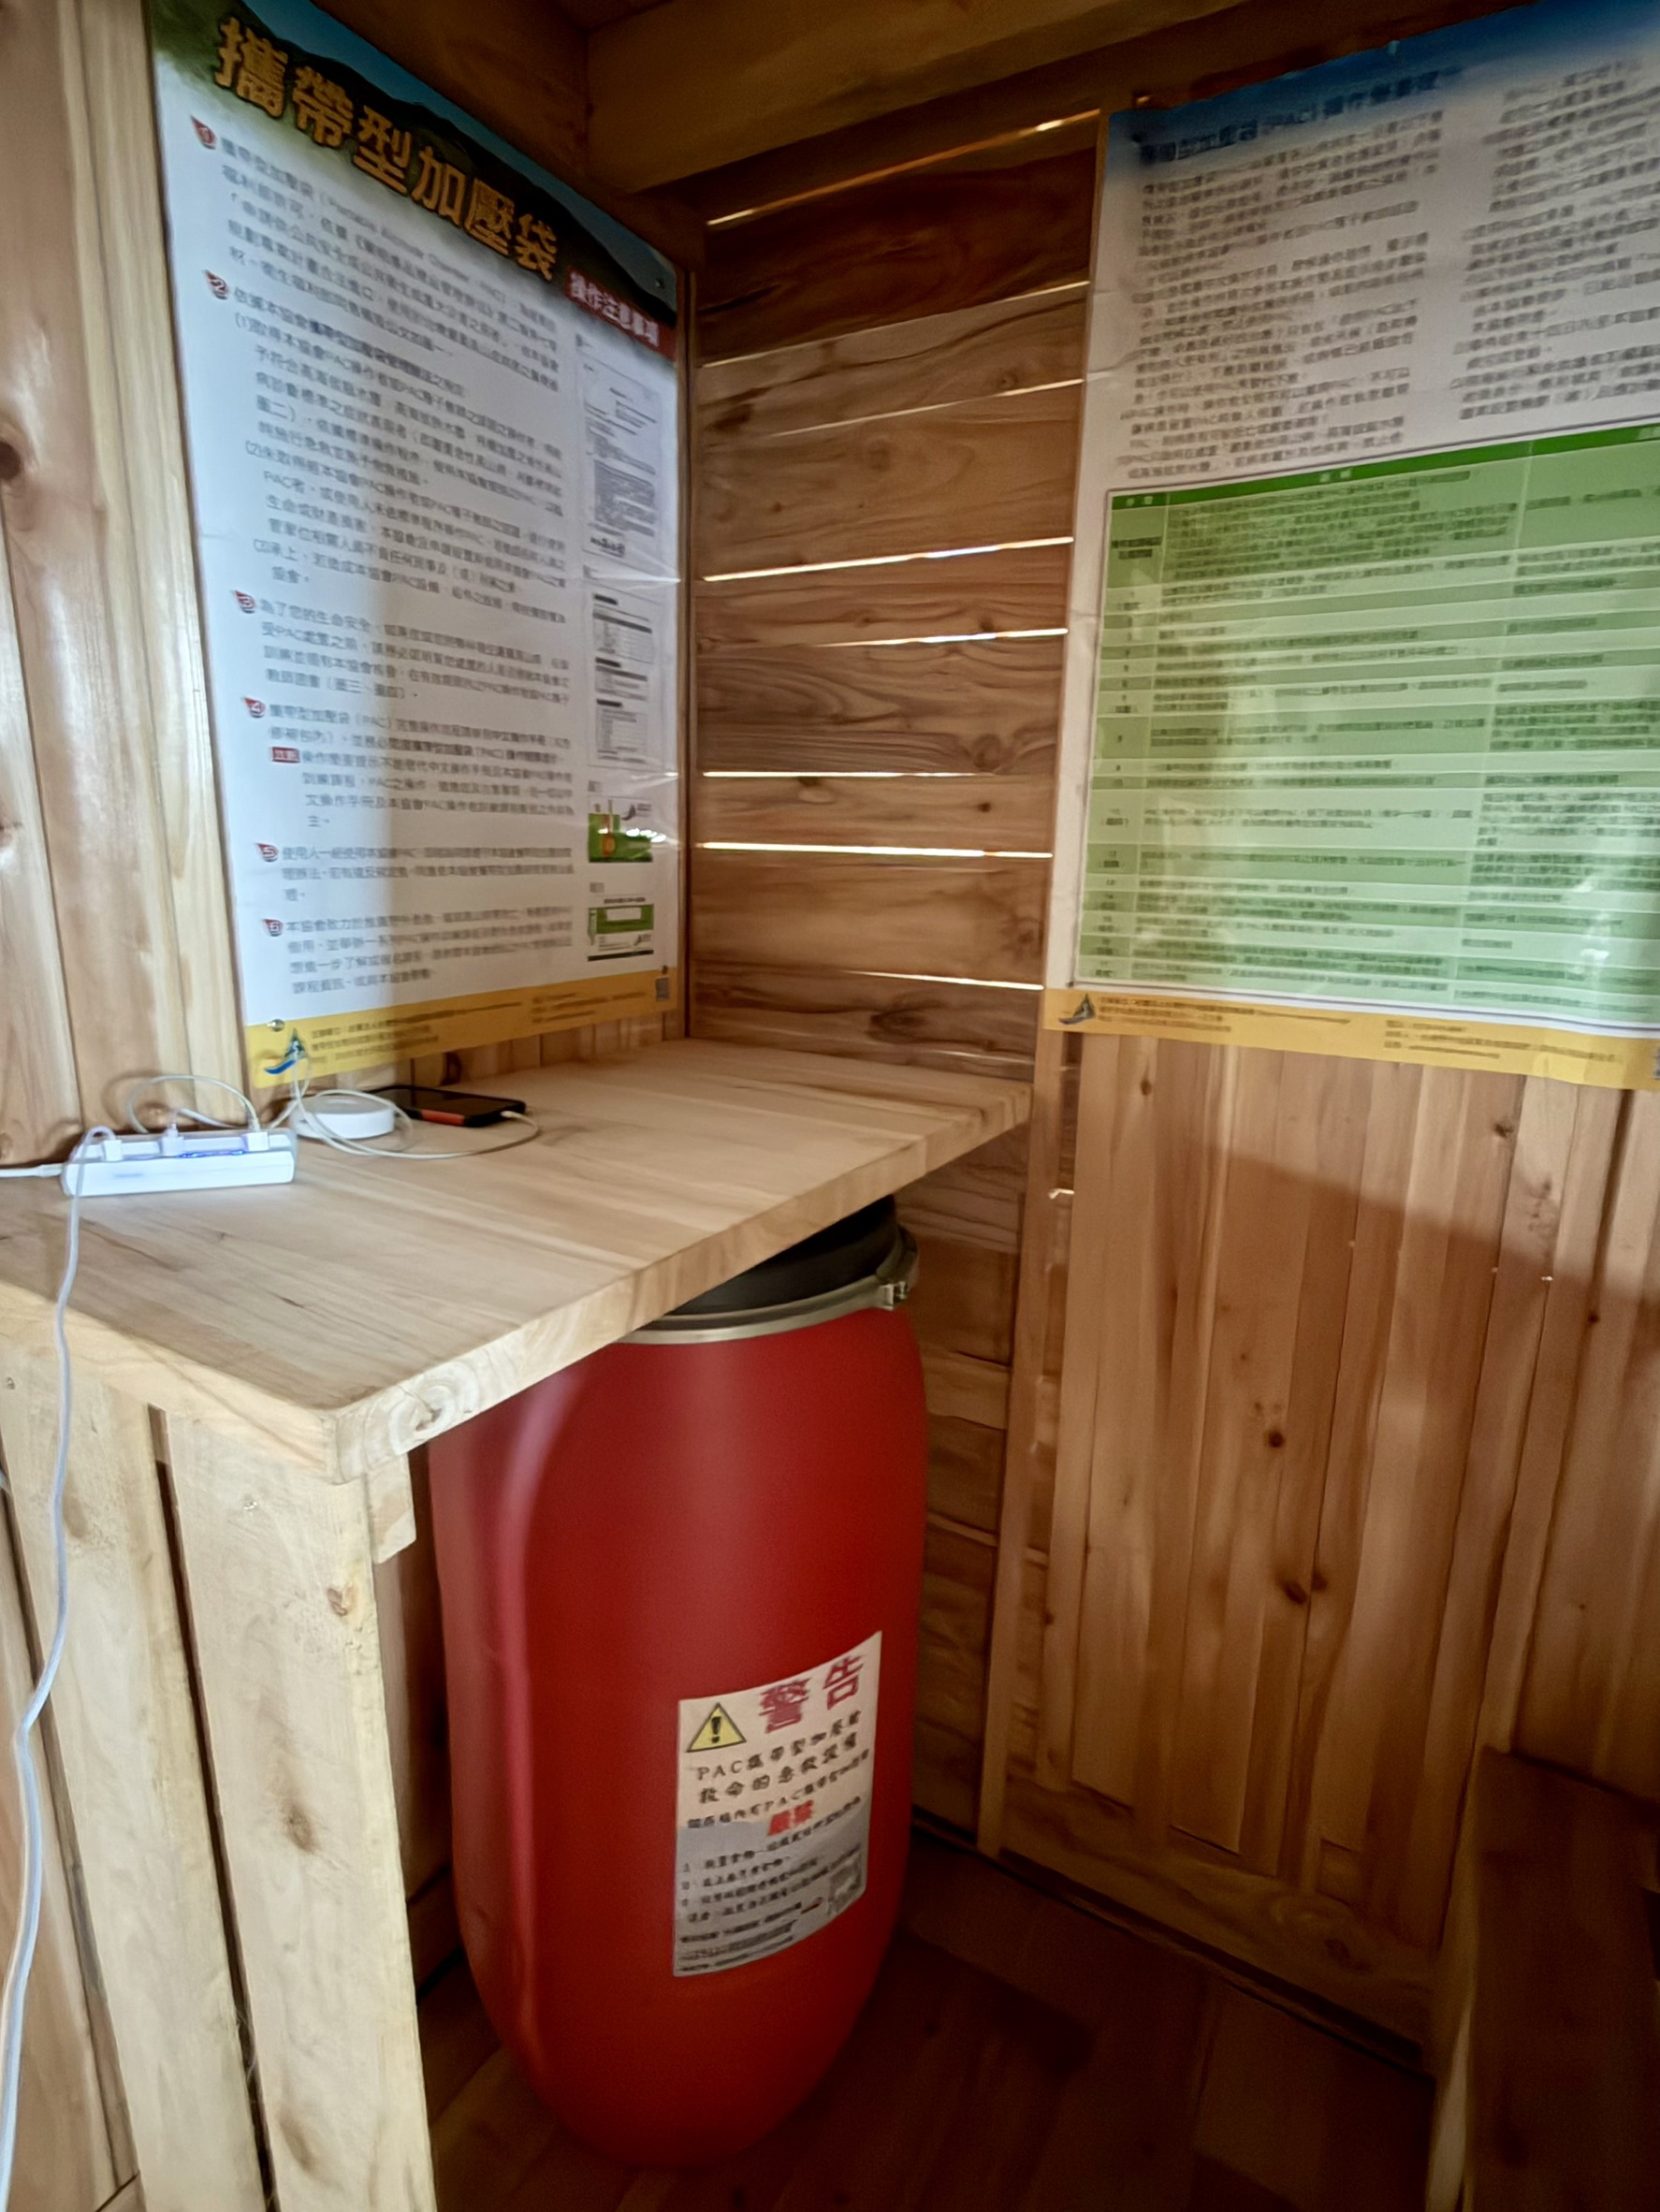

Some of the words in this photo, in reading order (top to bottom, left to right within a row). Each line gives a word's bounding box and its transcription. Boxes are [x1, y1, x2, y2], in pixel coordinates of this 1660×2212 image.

[214, 15, 559, 281] 攜帶型加壓袋
[759, 1656, 863, 1734] 警告
